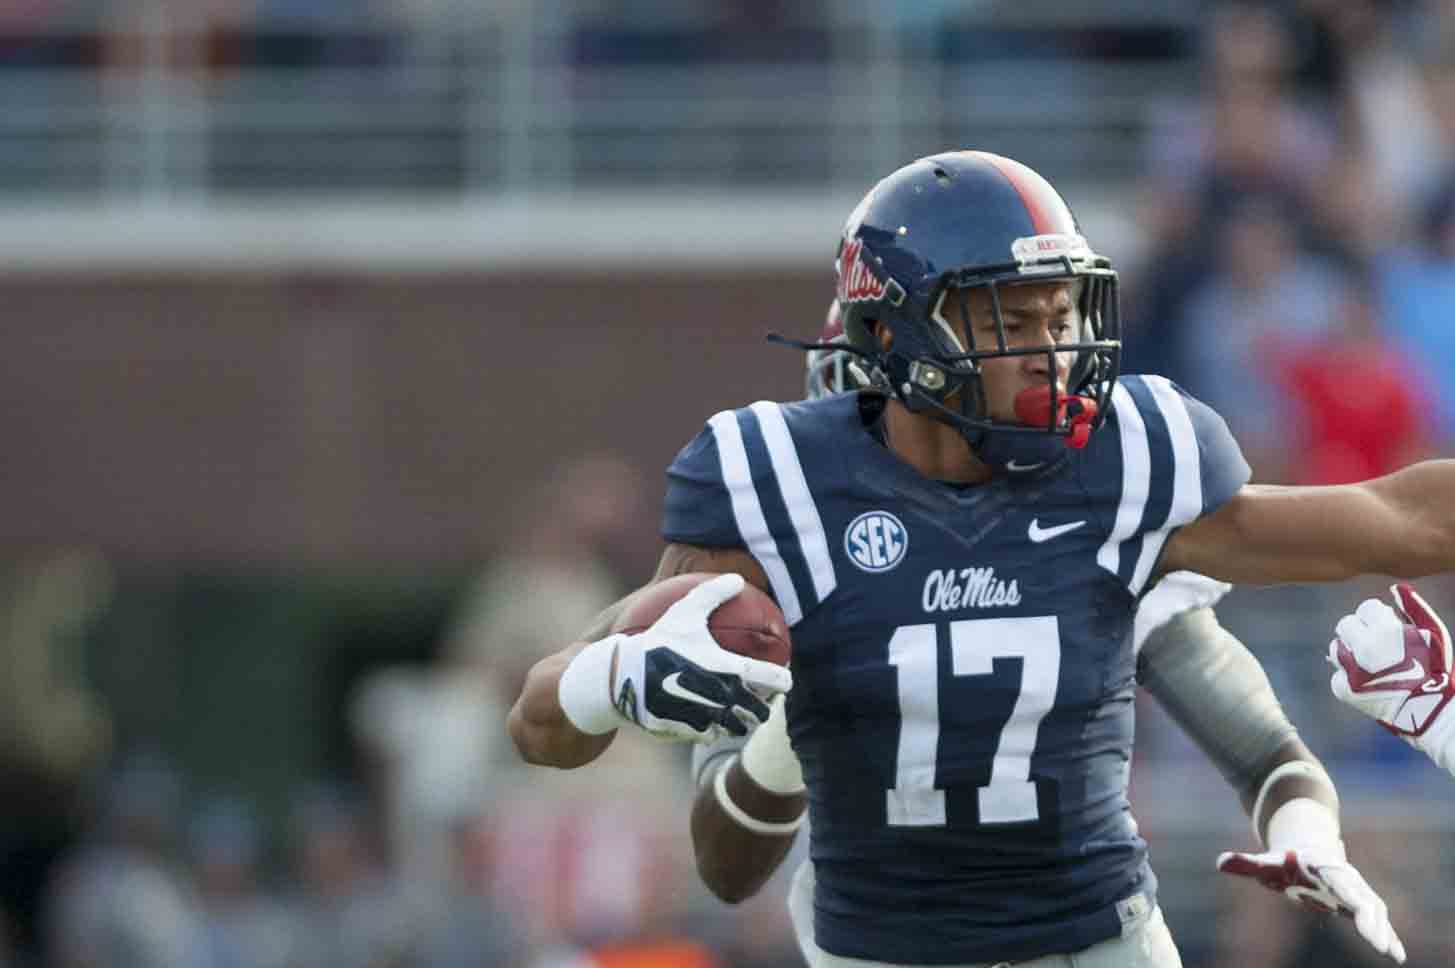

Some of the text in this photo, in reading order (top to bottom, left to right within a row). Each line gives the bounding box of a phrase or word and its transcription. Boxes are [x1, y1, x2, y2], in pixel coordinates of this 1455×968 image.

[848, 514, 903, 568] SEC
[923, 567, 1022, 612] Ole Miss
[886, 616, 1061, 825] 17
